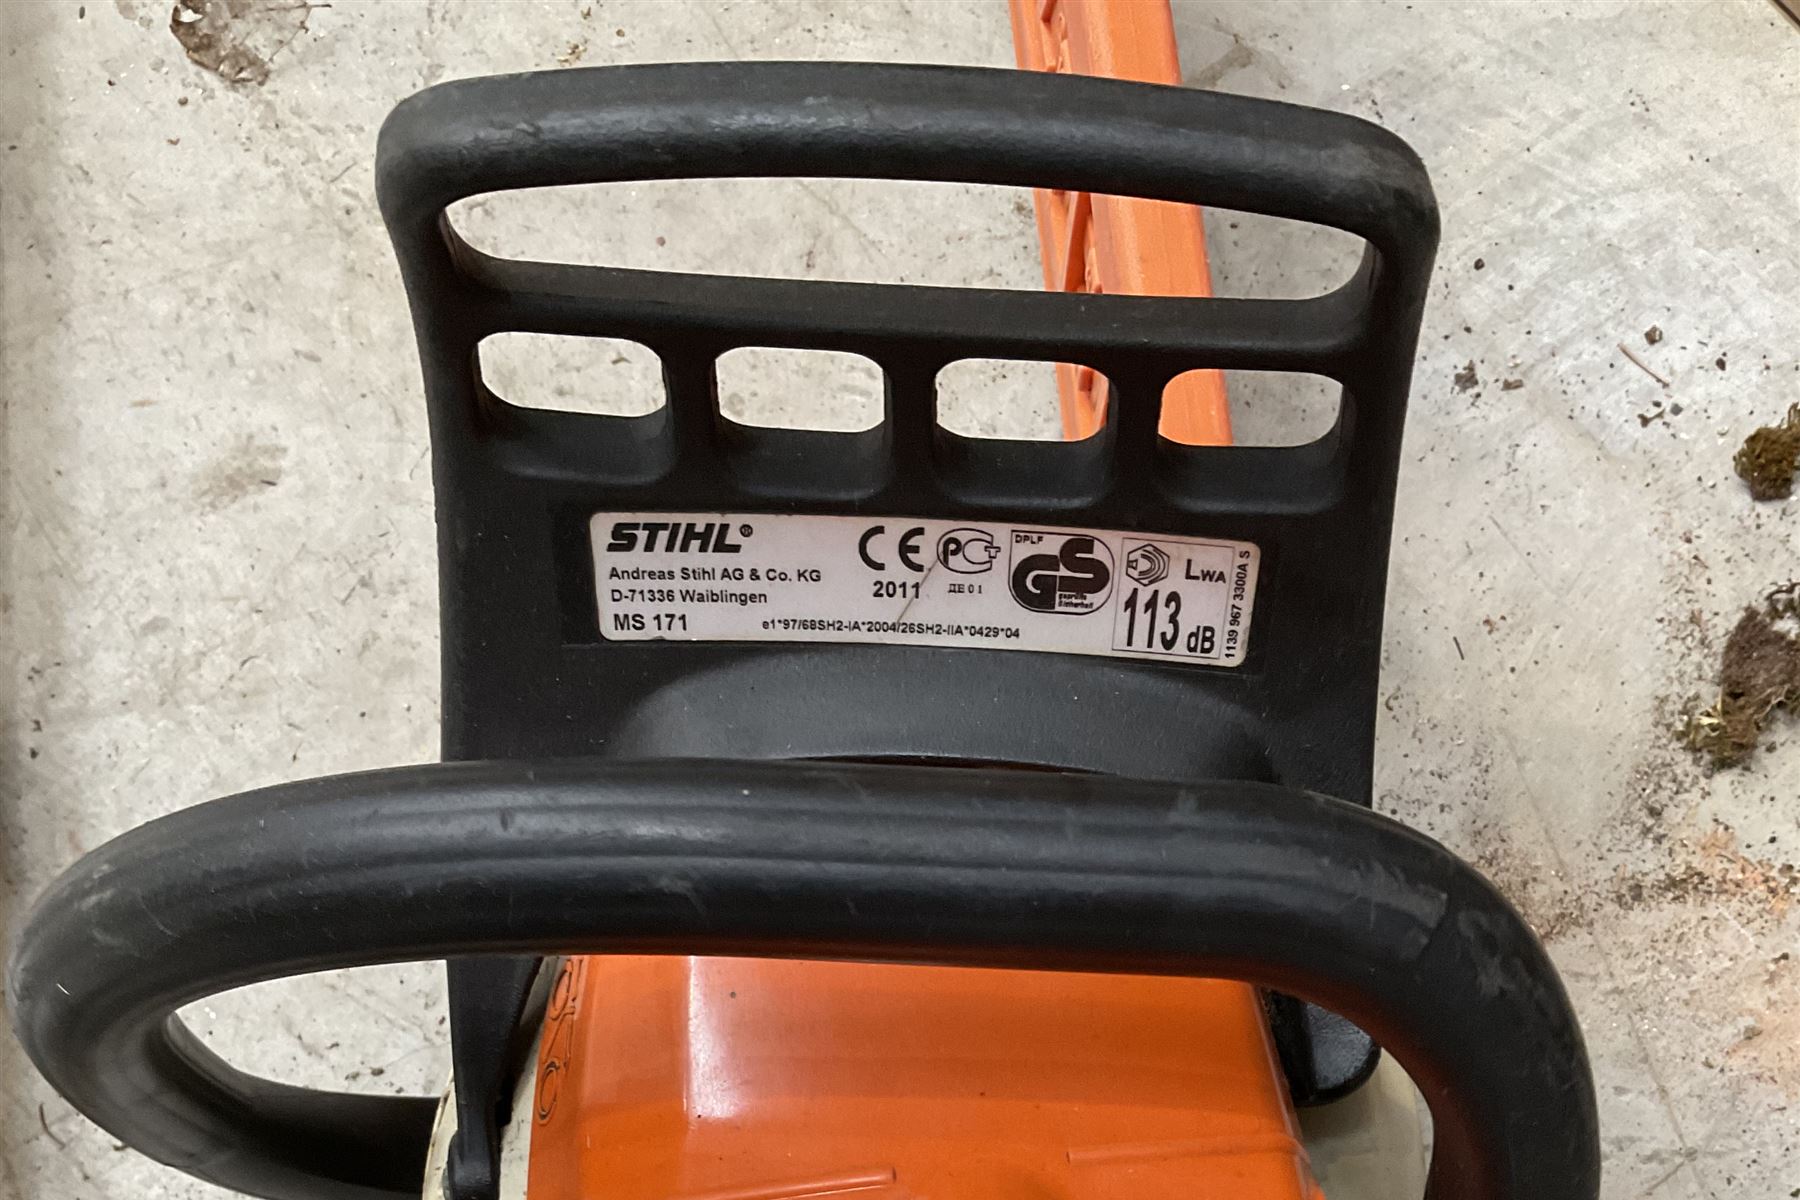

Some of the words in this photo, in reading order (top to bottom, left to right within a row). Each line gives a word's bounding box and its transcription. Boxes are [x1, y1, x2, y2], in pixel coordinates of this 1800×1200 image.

[1240, 550, 1250, 559] S
[609, 567, 675, 581] Andreas
[680, 567, 716, 581] Stihl
[720, 567, 744, 581] AG
[749, 568, 761, 581] &
[766, 568, 792, 582] Co.
[797, 568, 822, 582] KG
[1233, 563, 1249, 601] 3300A
[611, 589, 675, 603] D-71336
[680, 589, 768, 606] Waiblingen
[872, 581, 921, 599] 2011
[614, 614, 645, 631] MS
[653, 614, 688, 631] 171
[1124, 587, 1182, 651] 113
[1230, 604, 1243, 627] 967
[1186, 625, 1216, 654] dB
[1225, 630, 1239, 659] 1139
